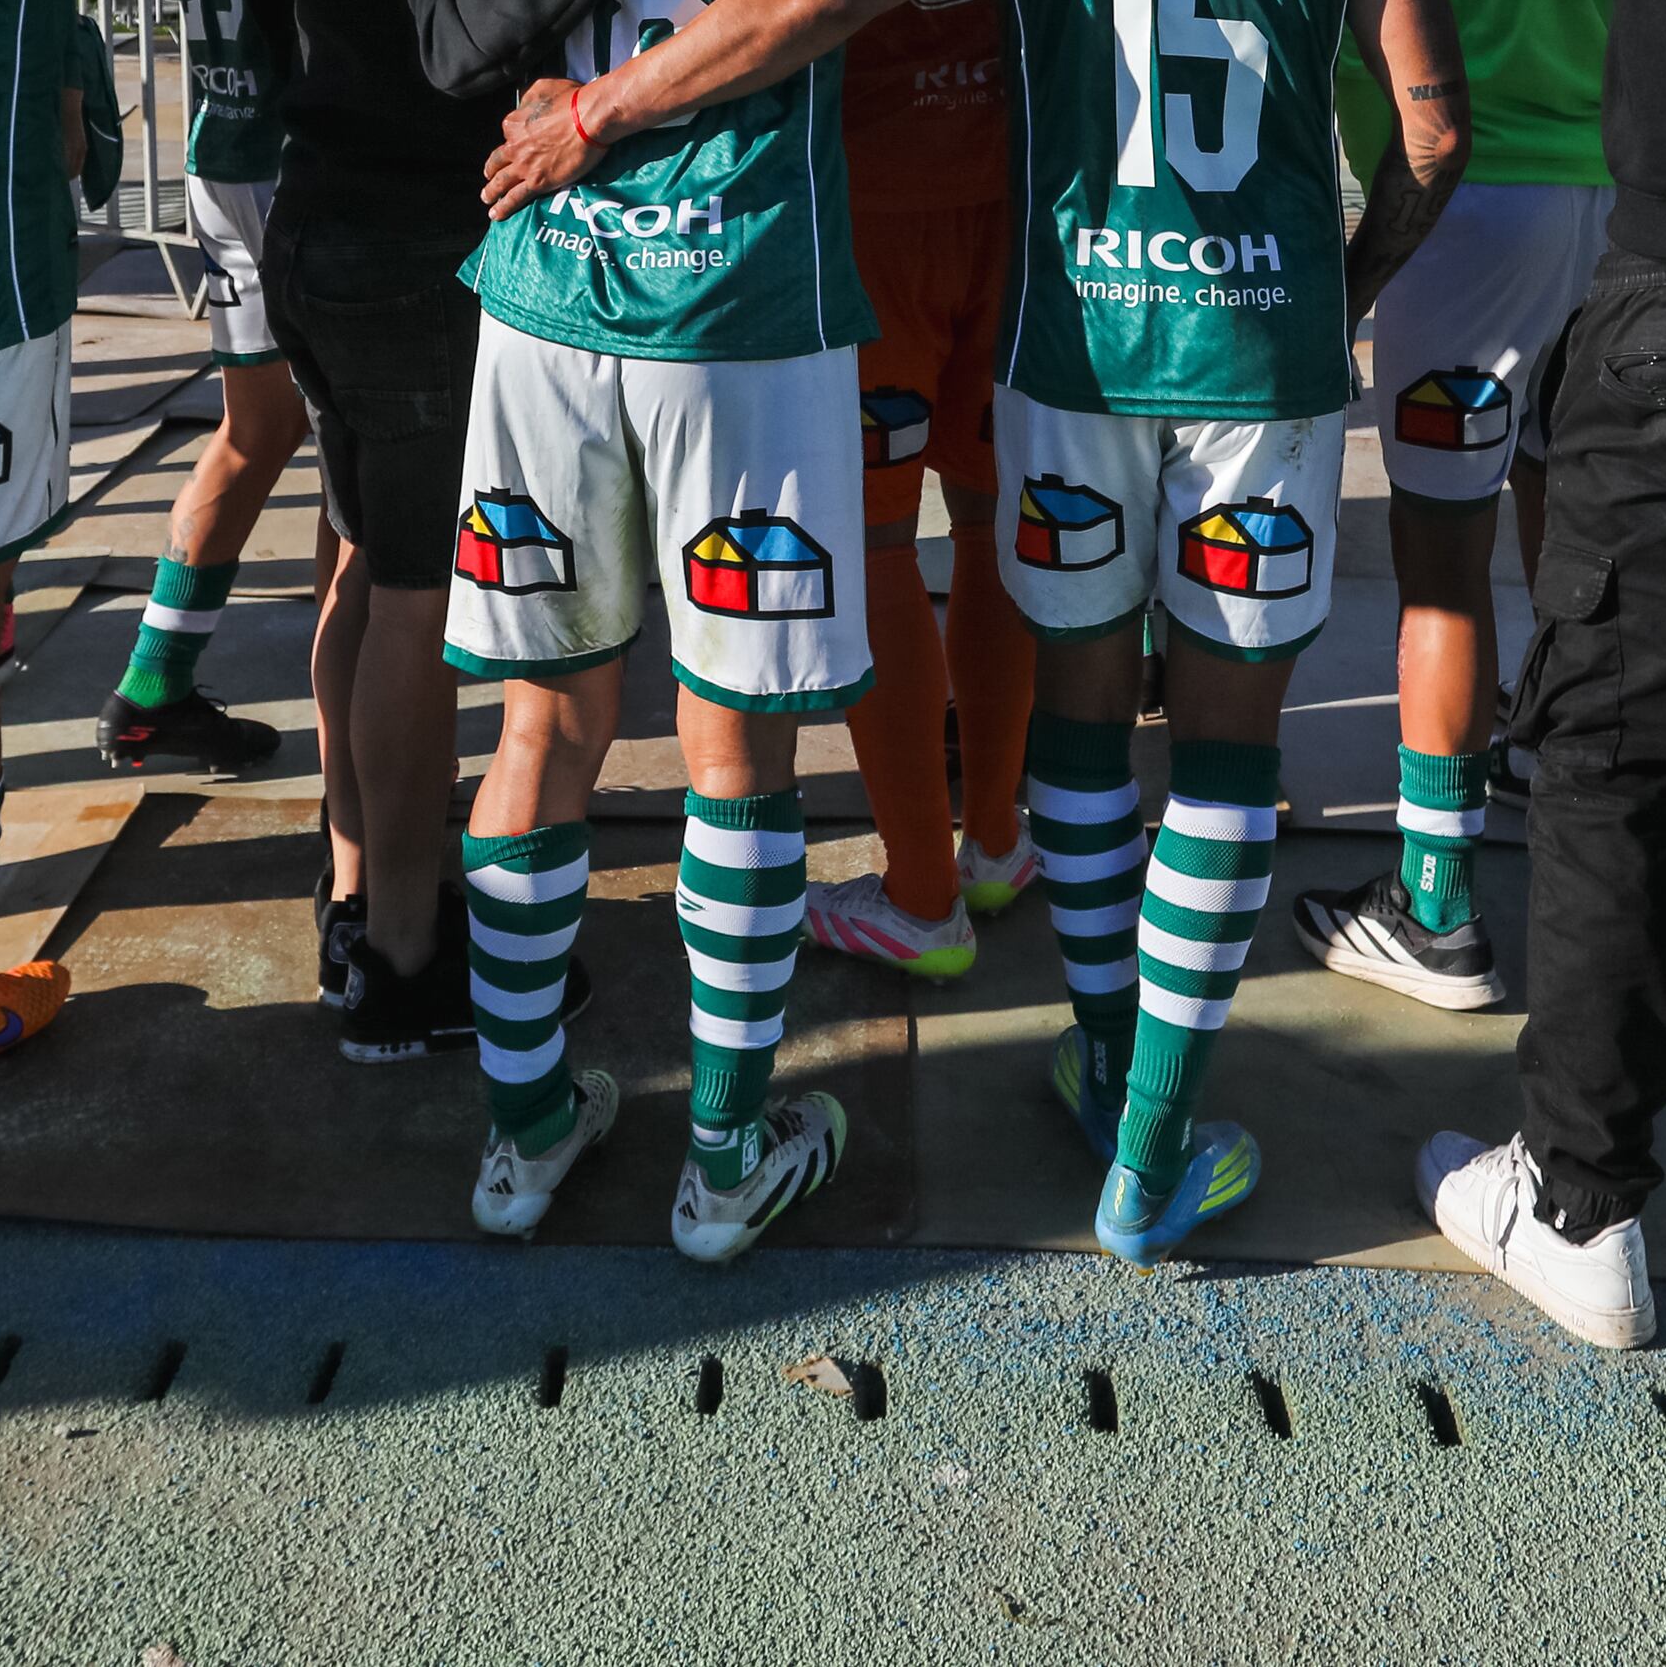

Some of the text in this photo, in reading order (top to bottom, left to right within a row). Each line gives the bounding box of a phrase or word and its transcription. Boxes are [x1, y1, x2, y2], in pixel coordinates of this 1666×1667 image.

[548, 184, 723, 241] RCOH
[626, 246, 733, 275] change.
[1076, 227, 1282, 276] RICOH
[1075, 274, 1188, 308] imagine.
[1195, 283, 1293, 311] change.
